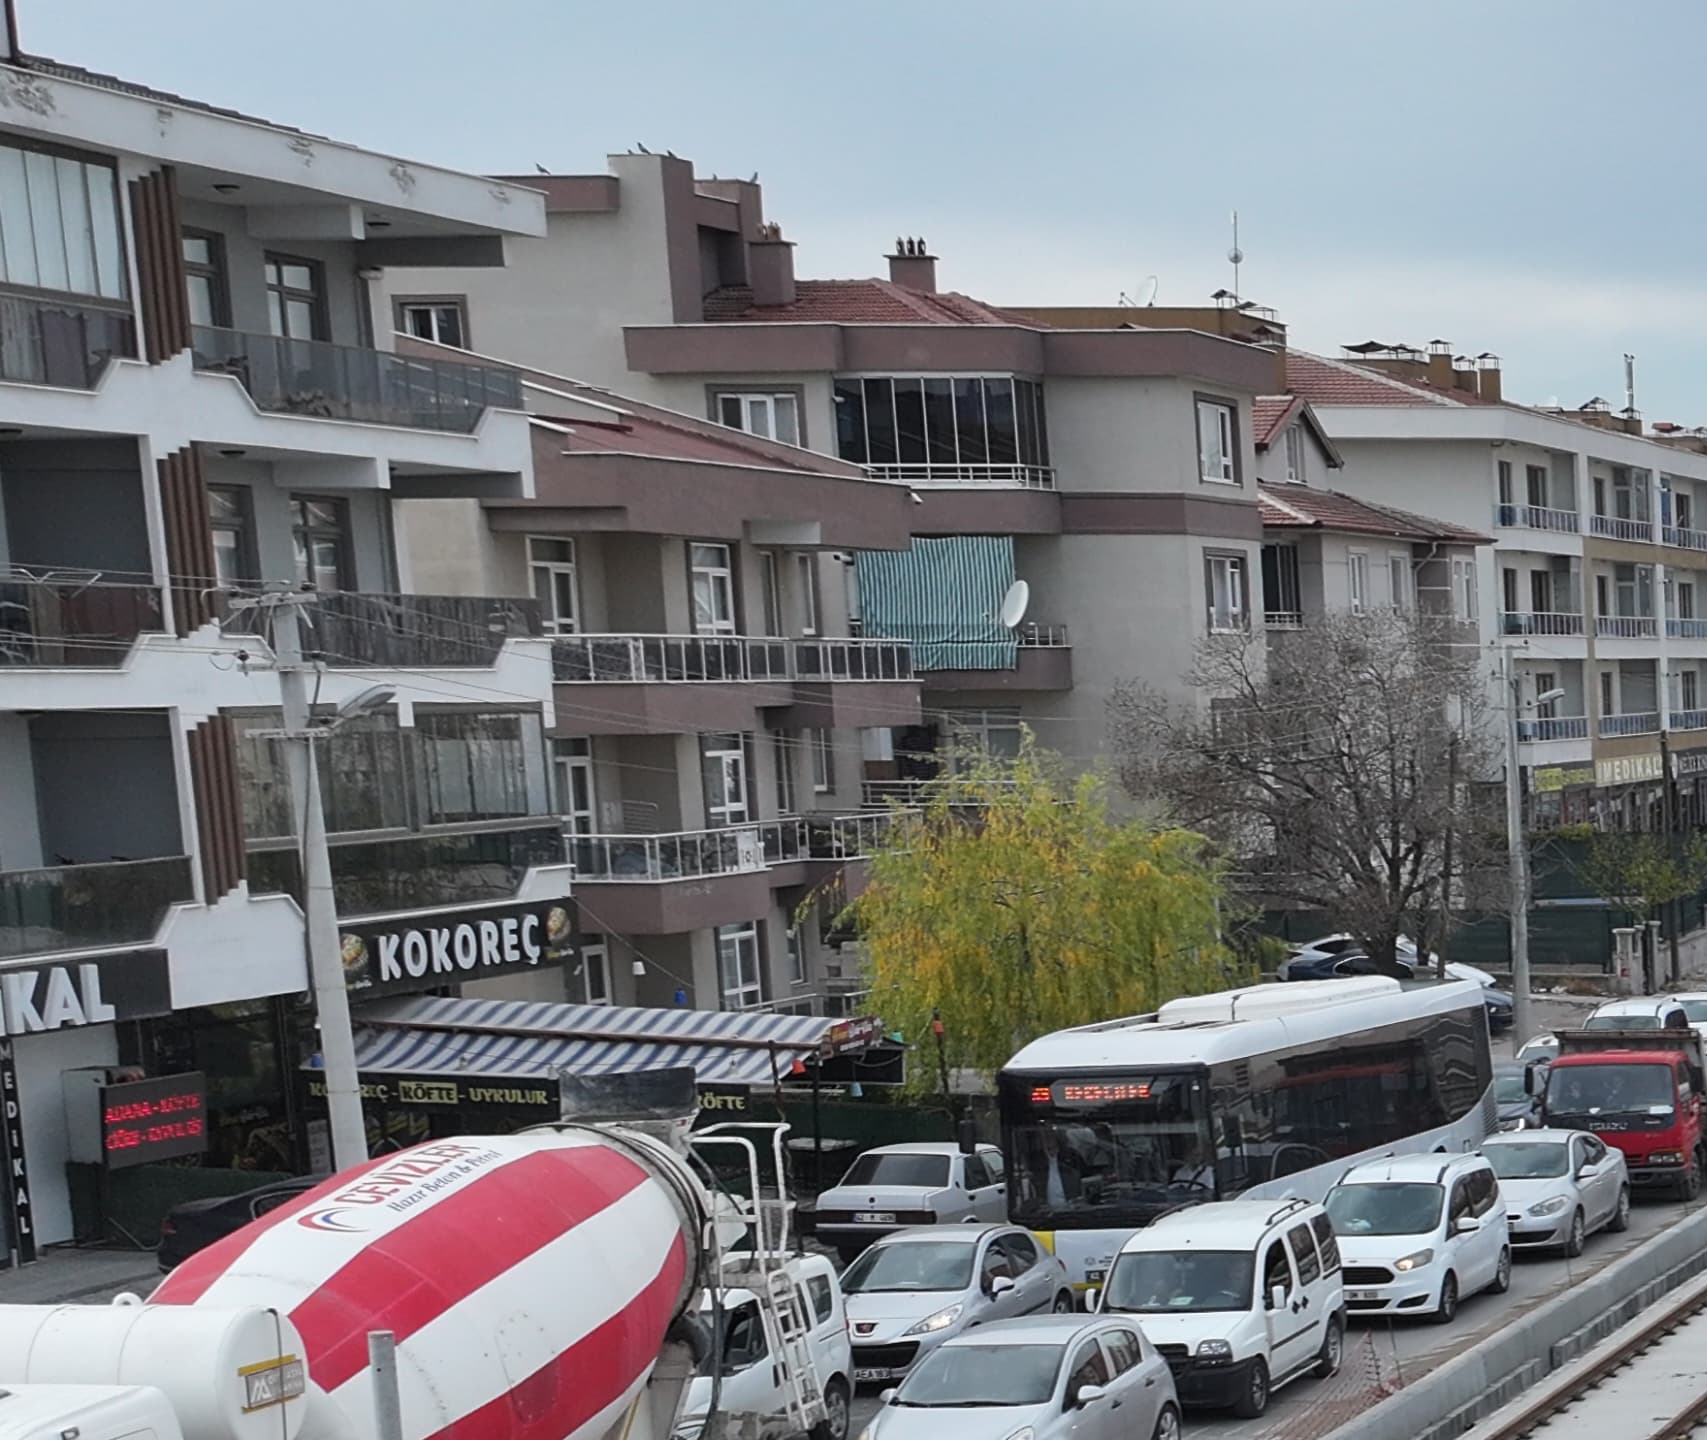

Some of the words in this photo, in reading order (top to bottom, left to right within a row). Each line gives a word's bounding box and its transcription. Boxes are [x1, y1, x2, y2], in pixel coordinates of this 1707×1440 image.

[378, 913, 541, 983] KOKOREÇ
[0, 963, 116, 1037] KAL
[401, 1082, 456, 1102] KÖFTE
